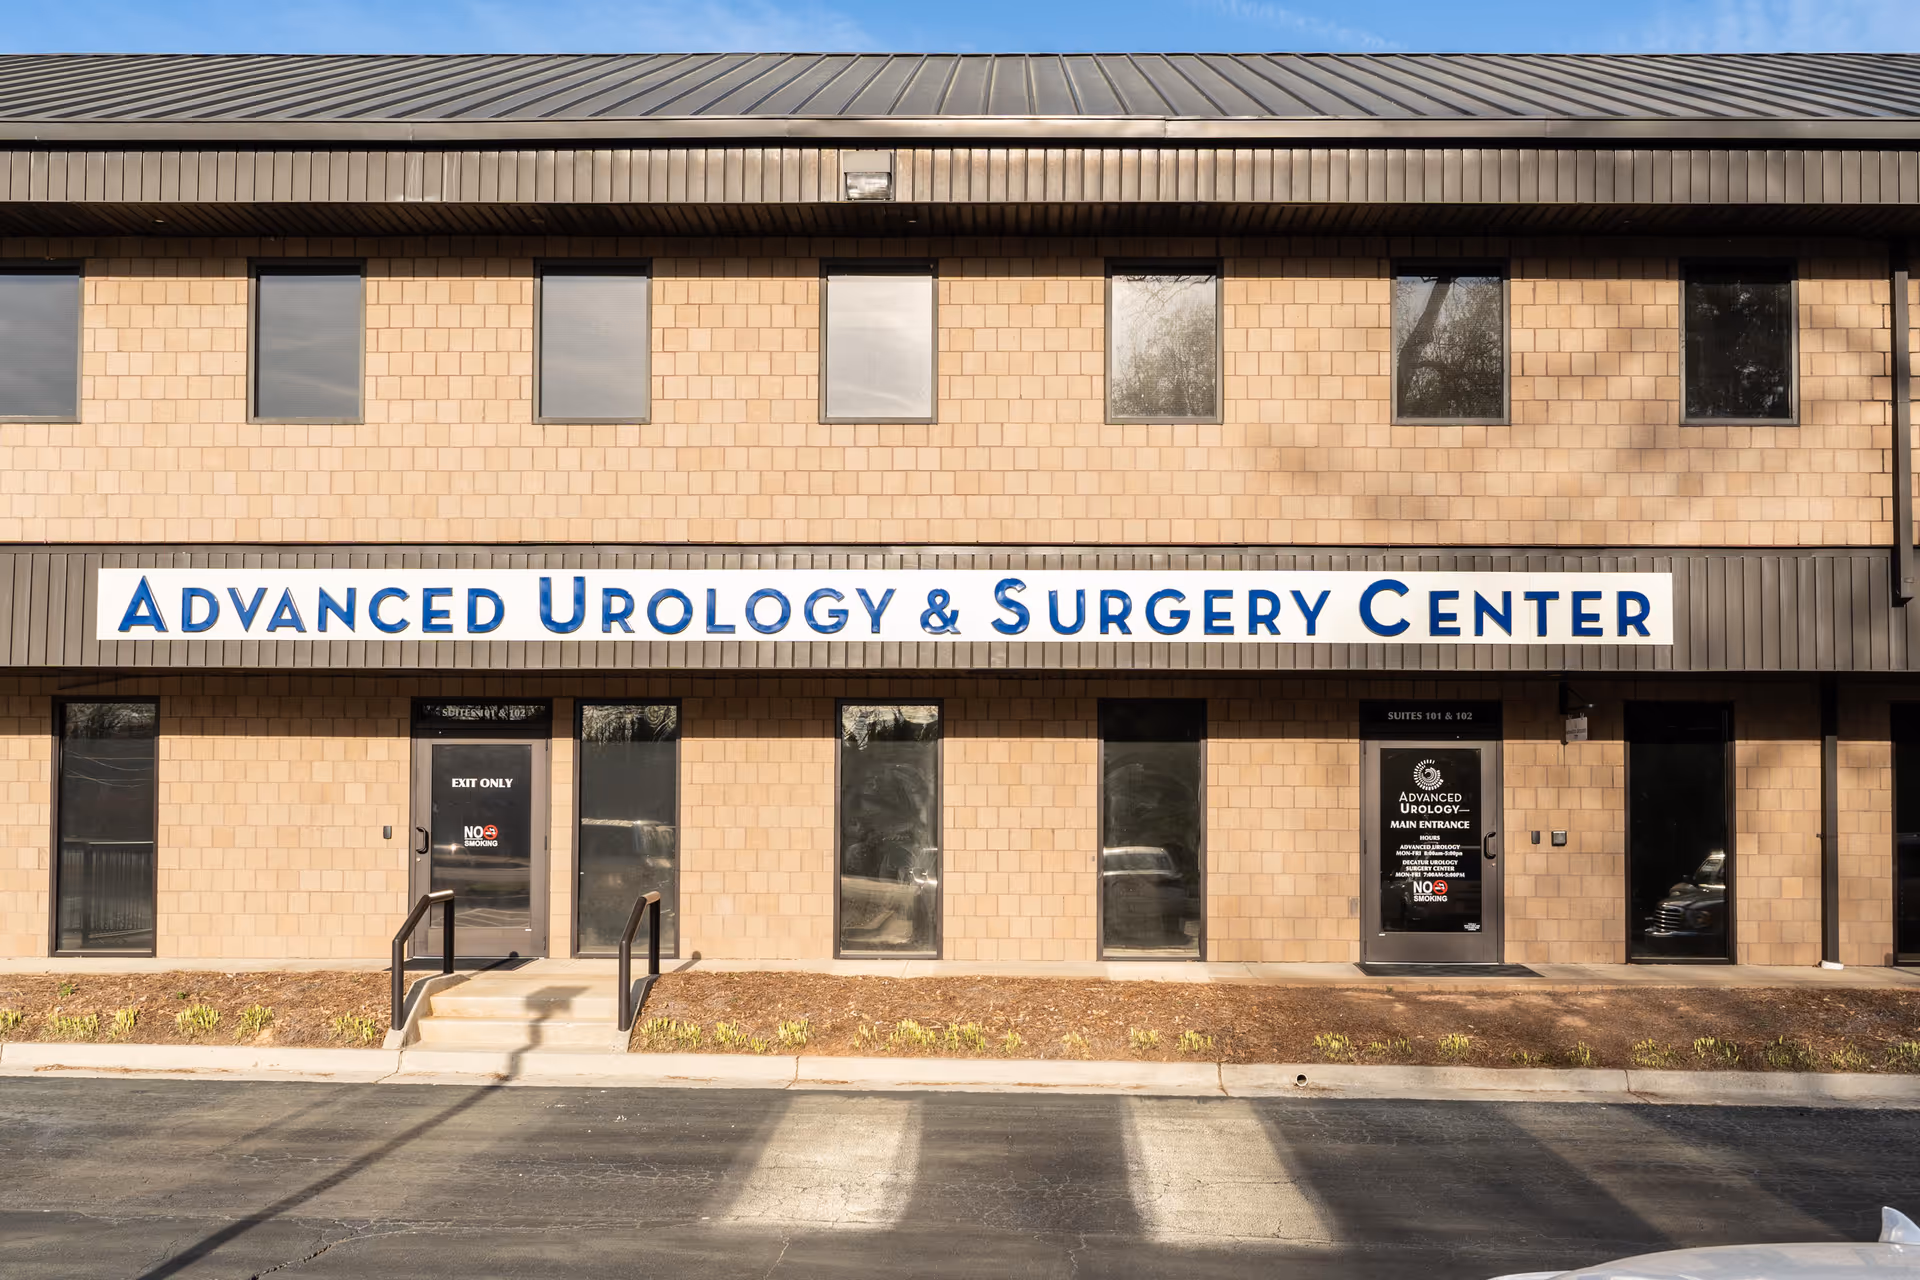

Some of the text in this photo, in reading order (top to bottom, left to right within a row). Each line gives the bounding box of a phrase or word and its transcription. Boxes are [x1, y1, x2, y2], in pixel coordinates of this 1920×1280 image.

[118, 575, 1652, 637] ADVANCED UROLOGY & SURGERY CENTER
[498, 708, 508, 717] &
[509, 708, 526, 717] 102
[1388, 711, 1473, 720] SUITES 101 & 102
[451, 778, 514, 788] EXIT ONLY
[1399, 791, 1462, 802] ADVANCED
[1400, 803, 1460, 814] UROLOGY
[1390, 820, 1470, 829] MAIN ENTRANCE
[464, 825, 484, 838] NO
[1413, 880, 1433, 893] NO
